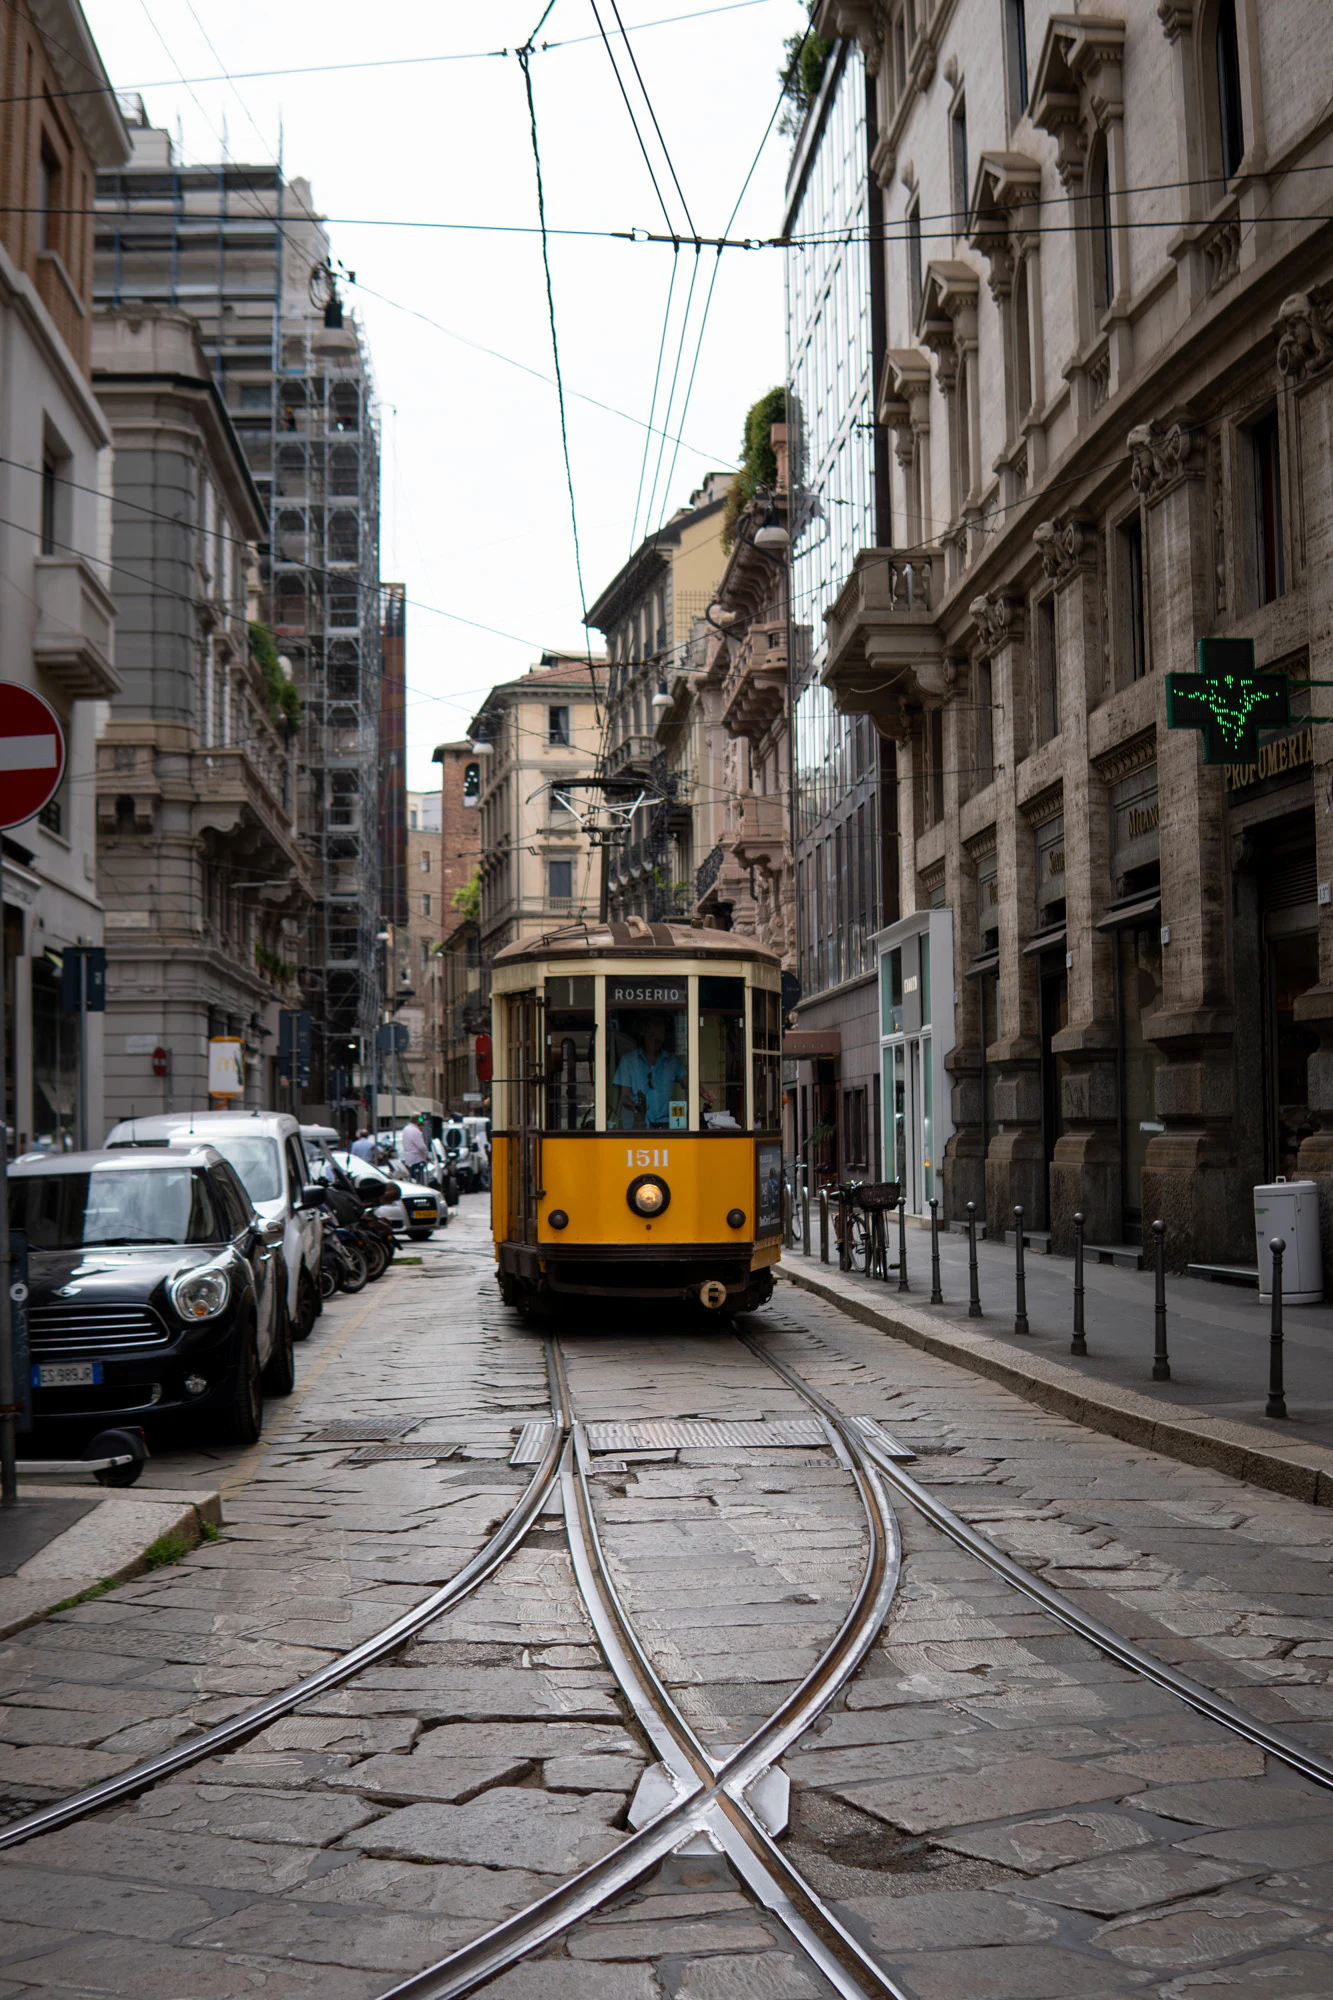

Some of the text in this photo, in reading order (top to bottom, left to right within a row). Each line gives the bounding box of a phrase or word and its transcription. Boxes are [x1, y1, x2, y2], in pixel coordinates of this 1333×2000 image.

[1224, 728, 1313, 793] PROFUMERIA
[614, 988, 679, 1001] ROSERIO
[672, 1105, 684, 1116] 11
[675, 1118, 680, 1127] 1
[626, 1149, 669, 1168] 1511
